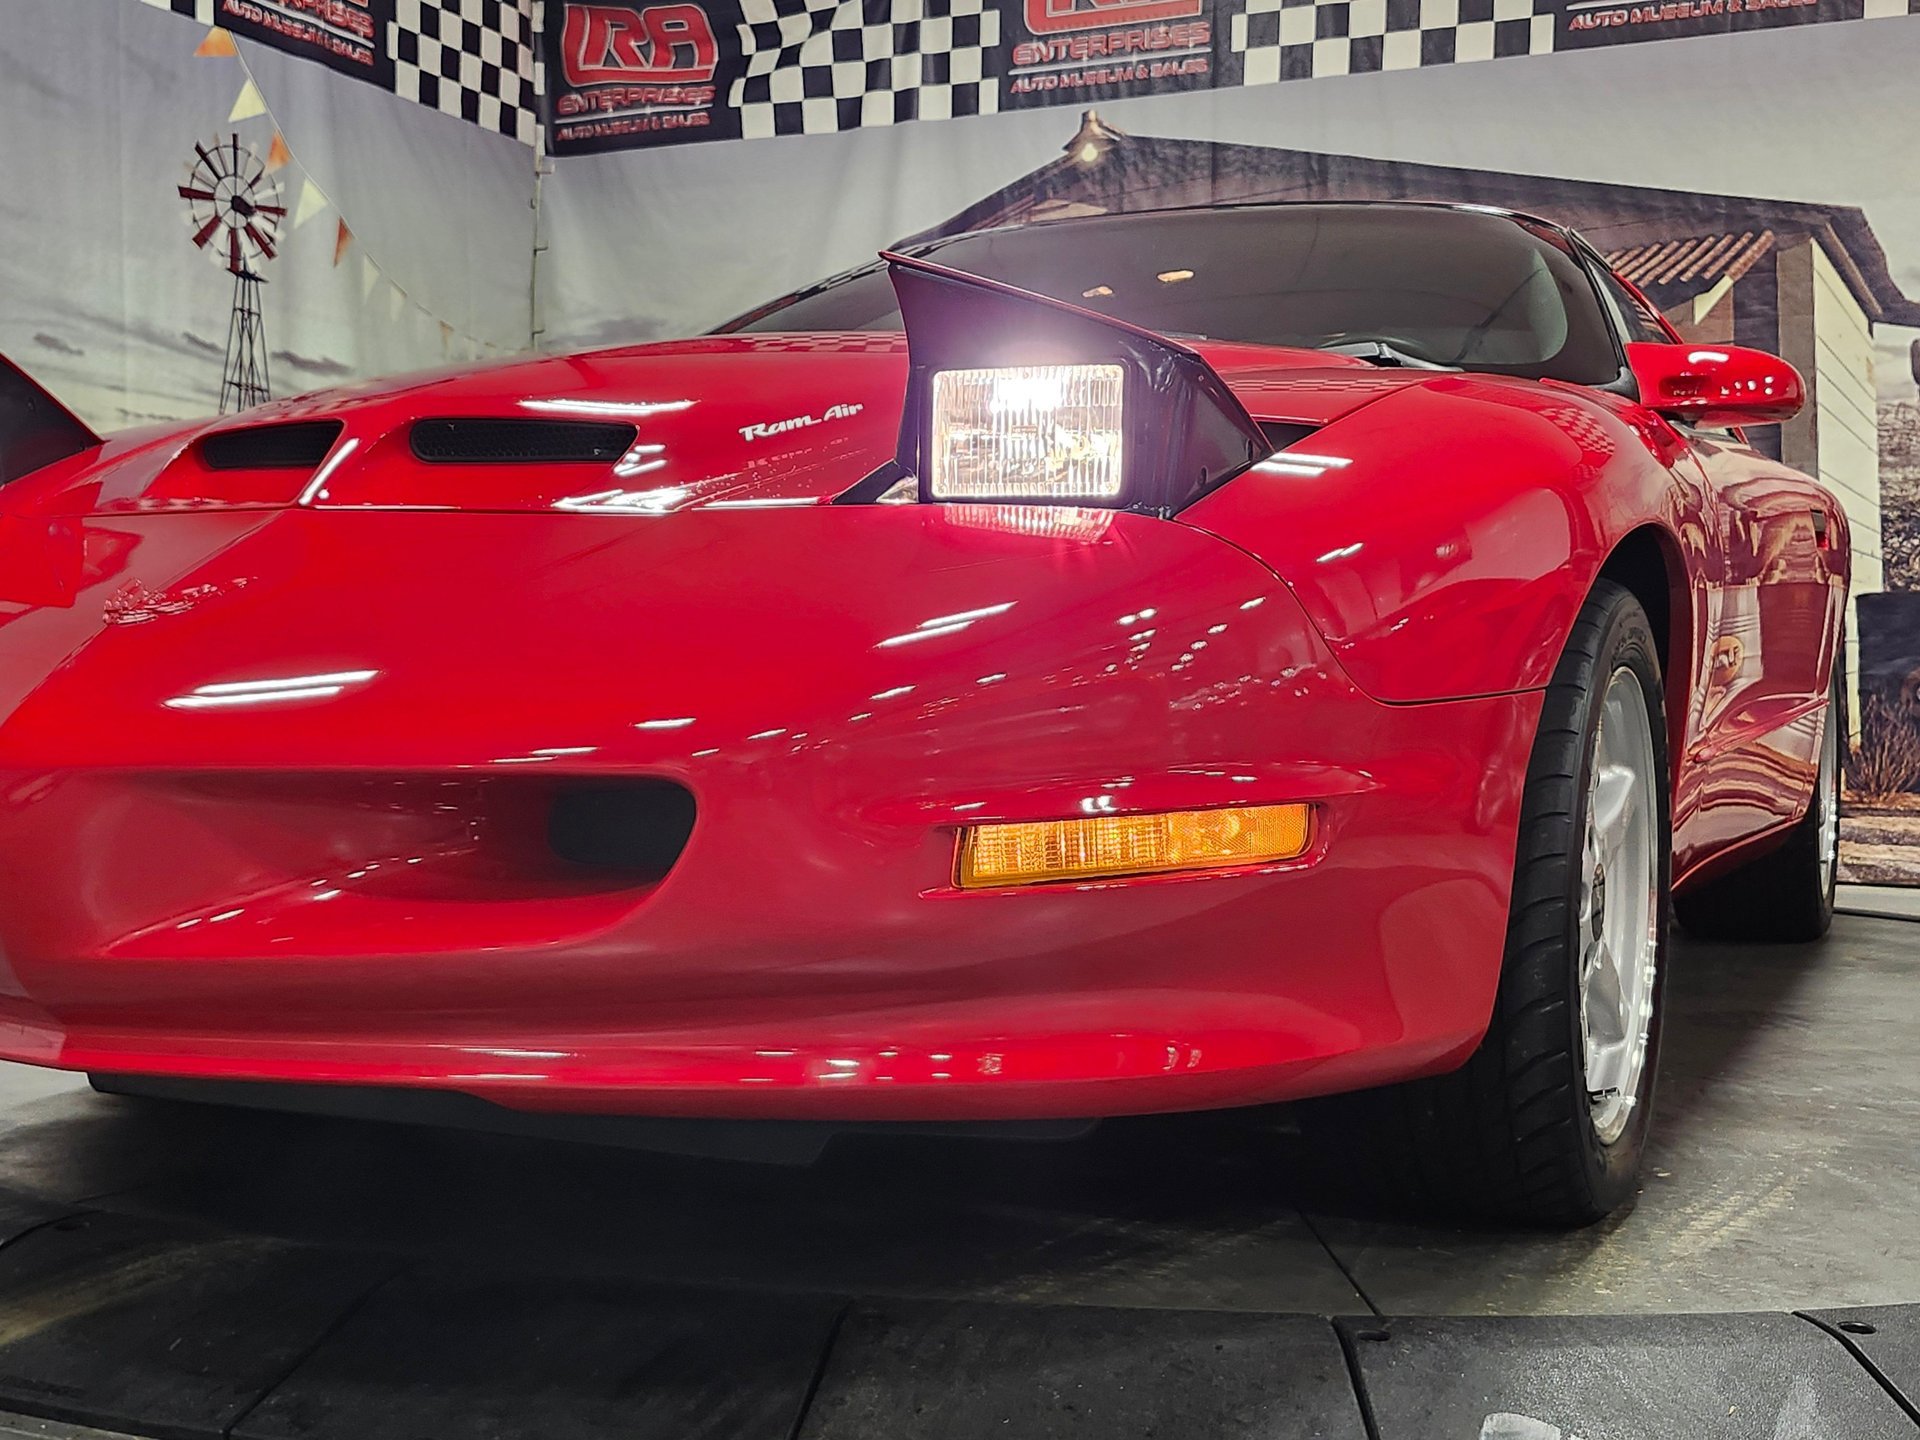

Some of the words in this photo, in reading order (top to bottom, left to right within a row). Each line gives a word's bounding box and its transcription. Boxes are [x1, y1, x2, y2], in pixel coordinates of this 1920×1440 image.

[1568, 9, 1628, 31] AUTO
[1629, 1, 1724, 24] MUSEUM
[1012, 21, 1212, 66] ENTERPRISES
[1010, 75, 1058, 94] AUTO
[1058, 64, 1134, 88] MUSEUM
[1135, 63, 1149, 80] &
[1150, 57, 1208, 78] SALES
[557, 85, 716, 115] ENTERPRISES
[738, 414, 822, 441] Ram
[823, 403, 864, 421] Air
